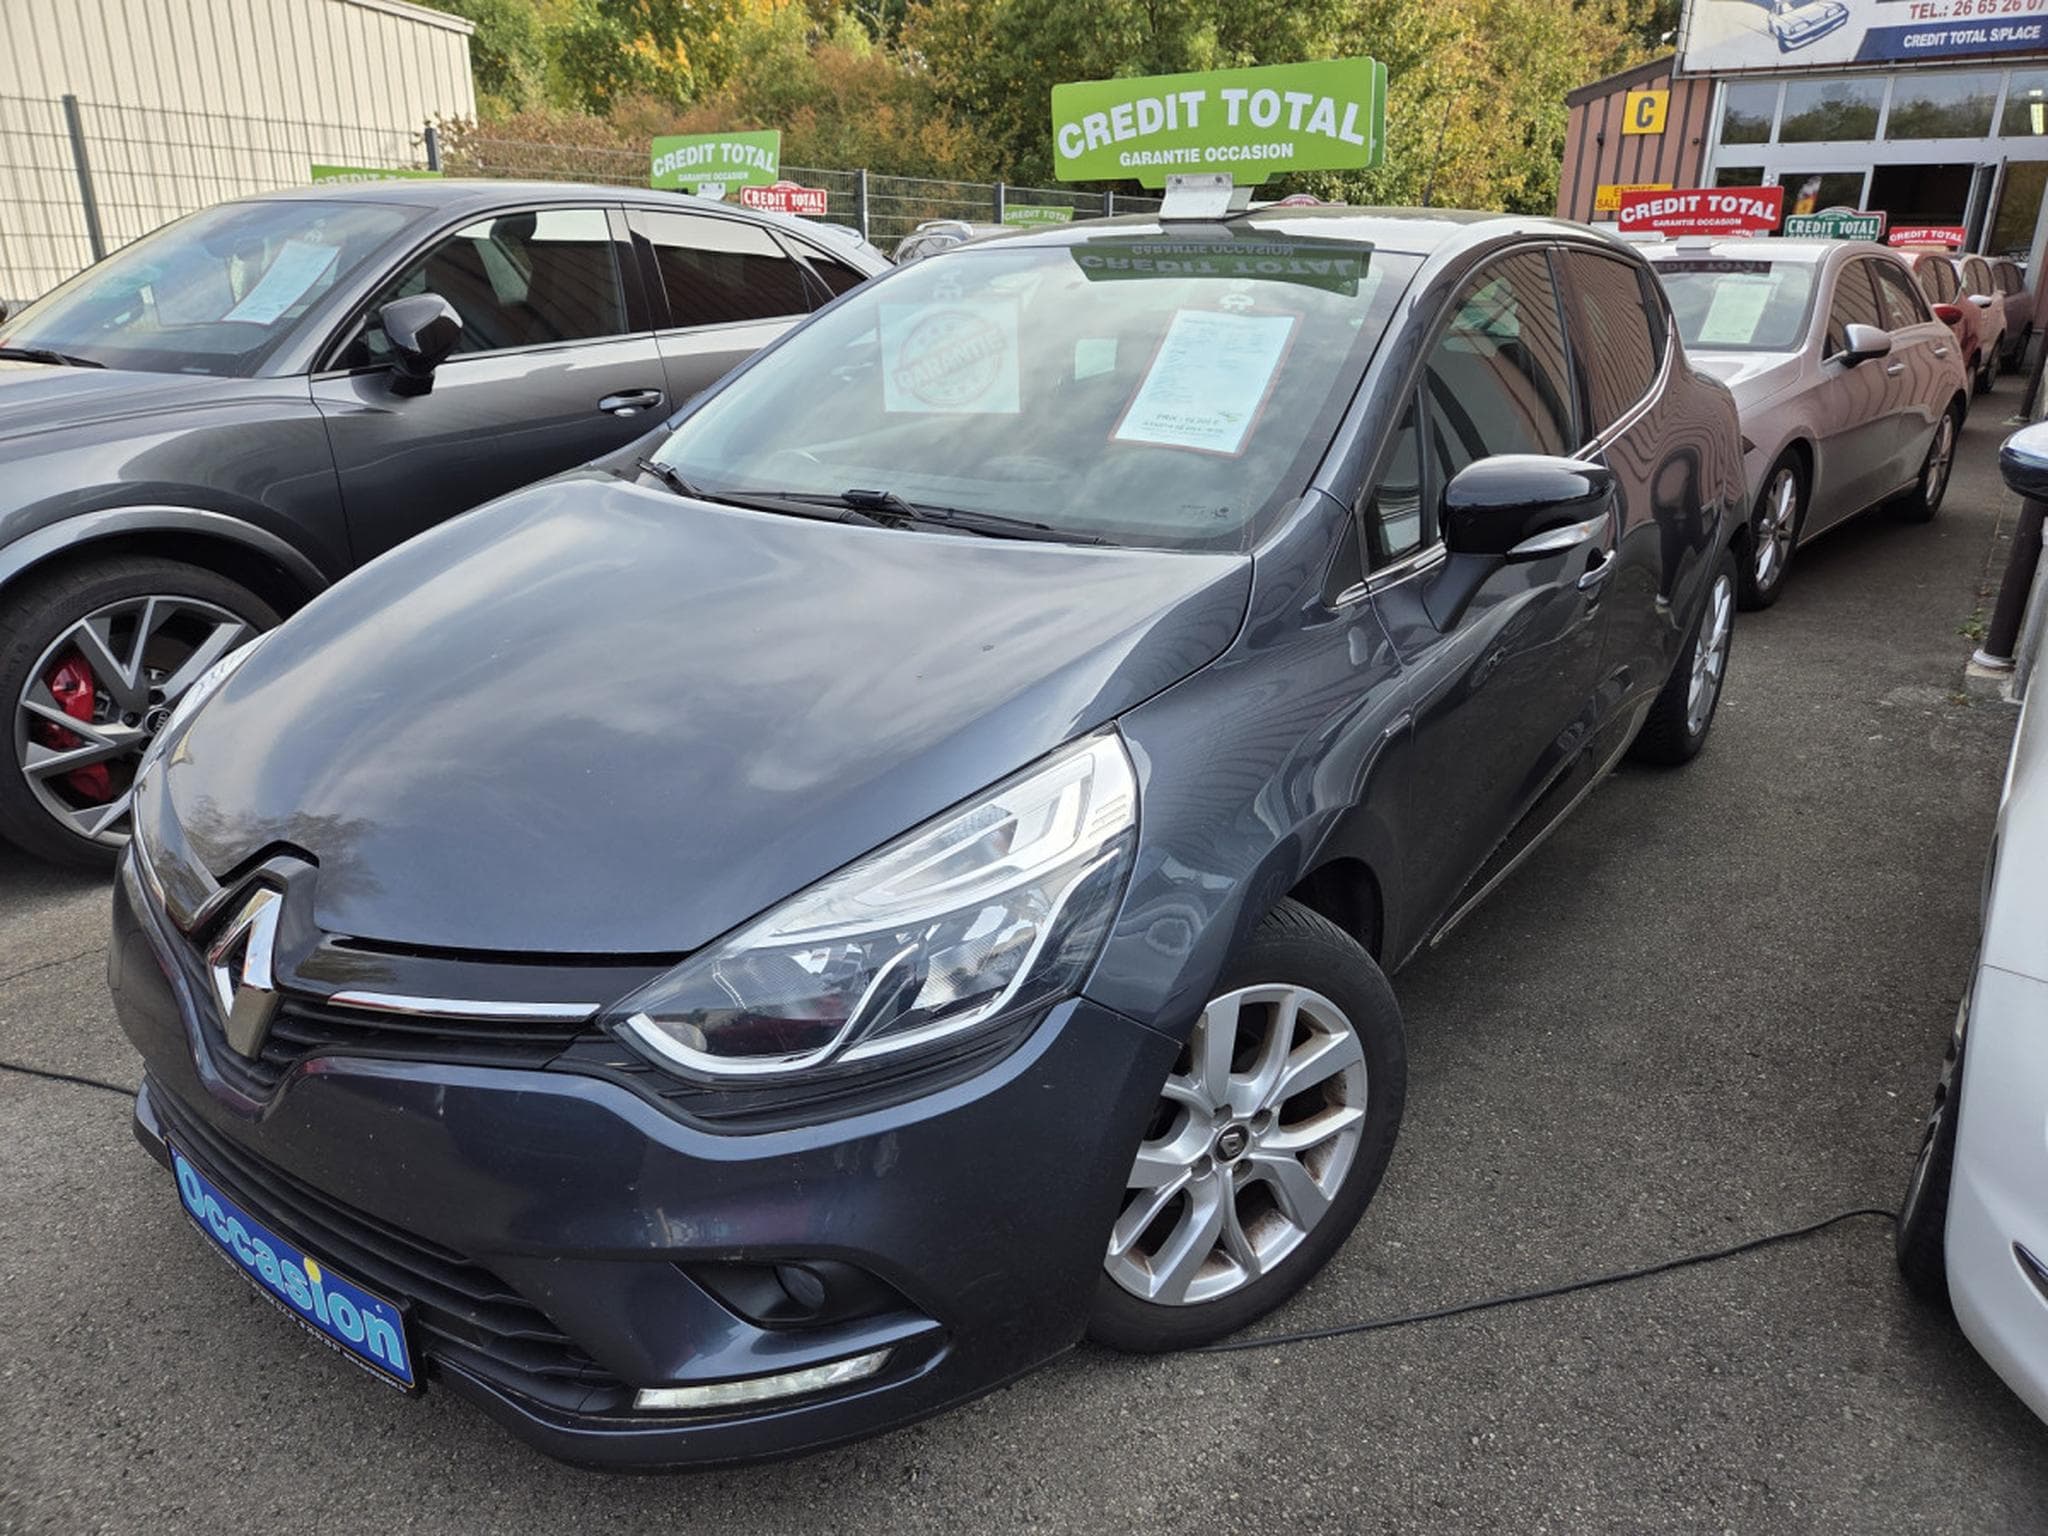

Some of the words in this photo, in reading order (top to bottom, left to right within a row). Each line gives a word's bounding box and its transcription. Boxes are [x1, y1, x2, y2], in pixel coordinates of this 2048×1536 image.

[1952, 0, 1973, 16] 26
[1978, 0, 1997, 14] 65
[2002, 0, 2022, 13] 26
[1903, 31, 1948, 48] CREDIT
[1950, 29, 1987, 45] TOTAL
[1636, 95, 1655, 129] C
[1058, 90, 1206, 160] CREDIT
[1221, 88, 1365, 146] TOTAL
[653, 143, 716, 178] CREDIT
[720, 143, 776, 174] TOTAL
[1120, 149, 1200, 166] GARANTIE
[1204, 143, 1294, 162] OCCASION
[743, 189, 786, 207] CREDIT
[790, 193, 824, 208] TOTAL
[1004, 210, 1040, 221] CREDIT
[1621, 196, 1701, 223] CREDIT
[1707, 195, 1776, 221] TOTAL
[1652, 218, 1696, 227] GARANTIE
[1696, 217, 1742, 227] OCCASION
[1787, 219, 1834, 234] CREDIT
[1838, 219, 1876, 235] TOTAL
[1889, 230, 1928, 242] CREDIT
[1930, 229, 1962, 242] TOTAL
[175, 1156, 405, 1371] Occasion
